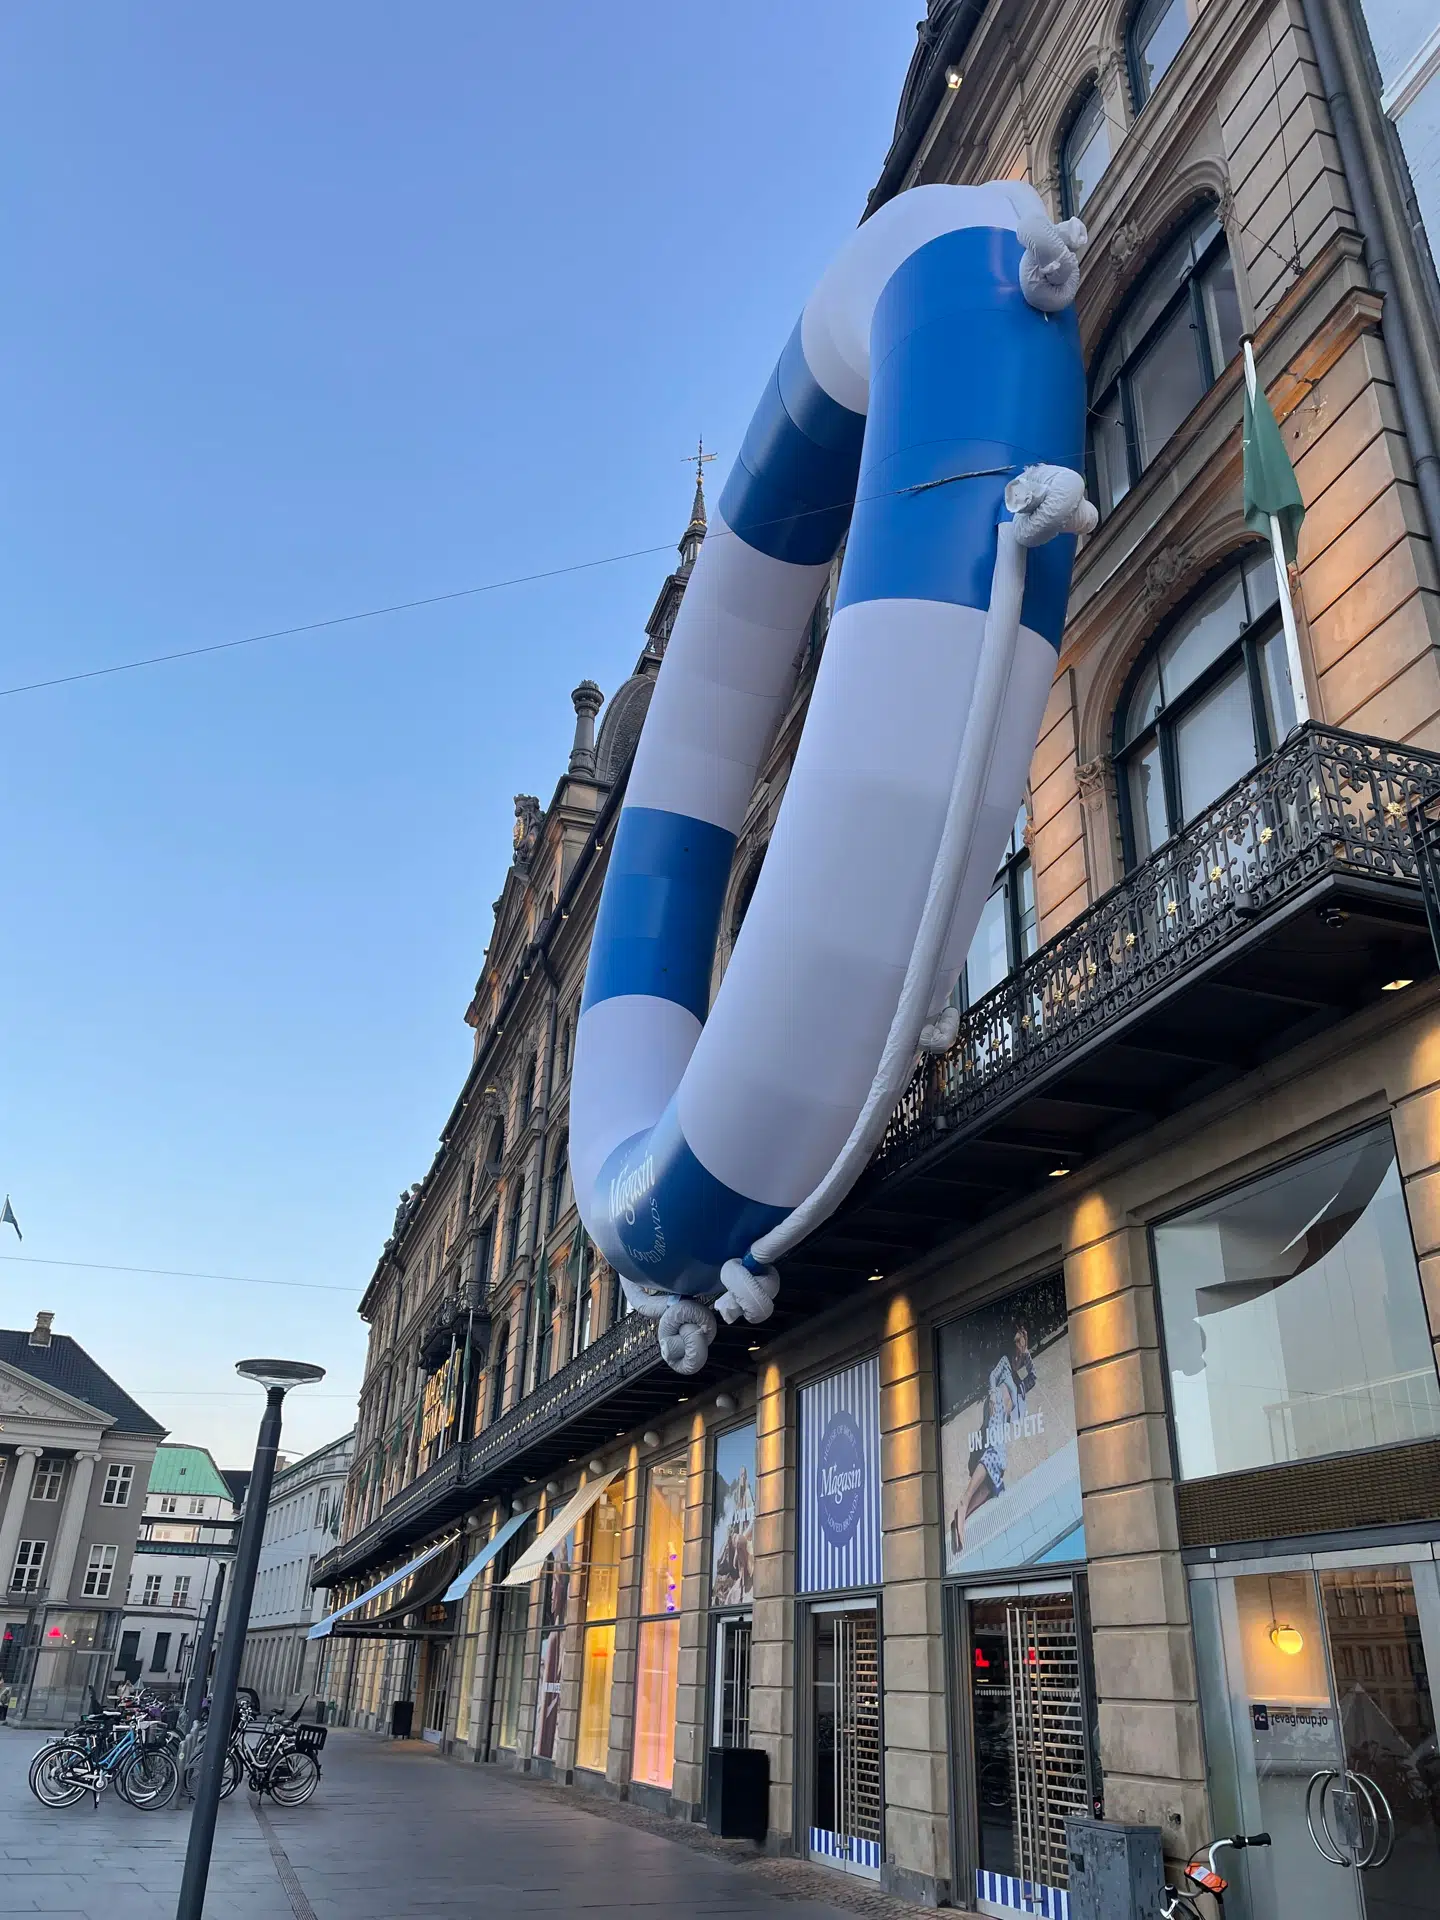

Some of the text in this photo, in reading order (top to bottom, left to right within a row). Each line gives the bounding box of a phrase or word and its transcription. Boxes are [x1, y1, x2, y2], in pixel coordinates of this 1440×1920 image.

[608, 1150, 656, 1225] Magasin
[649, 1196, 667, 1257] BRANDS
[823, 1428, 837, 1462] HOUSE
[836, 1424, 844, 1435] OF
[968, 1404, 1045, 1452] UN JOUR D'ÉTÉ
[820, 1462, 861, 1504] Magasin
[827, 1492, 859, 1533] LOVED BRANDS
